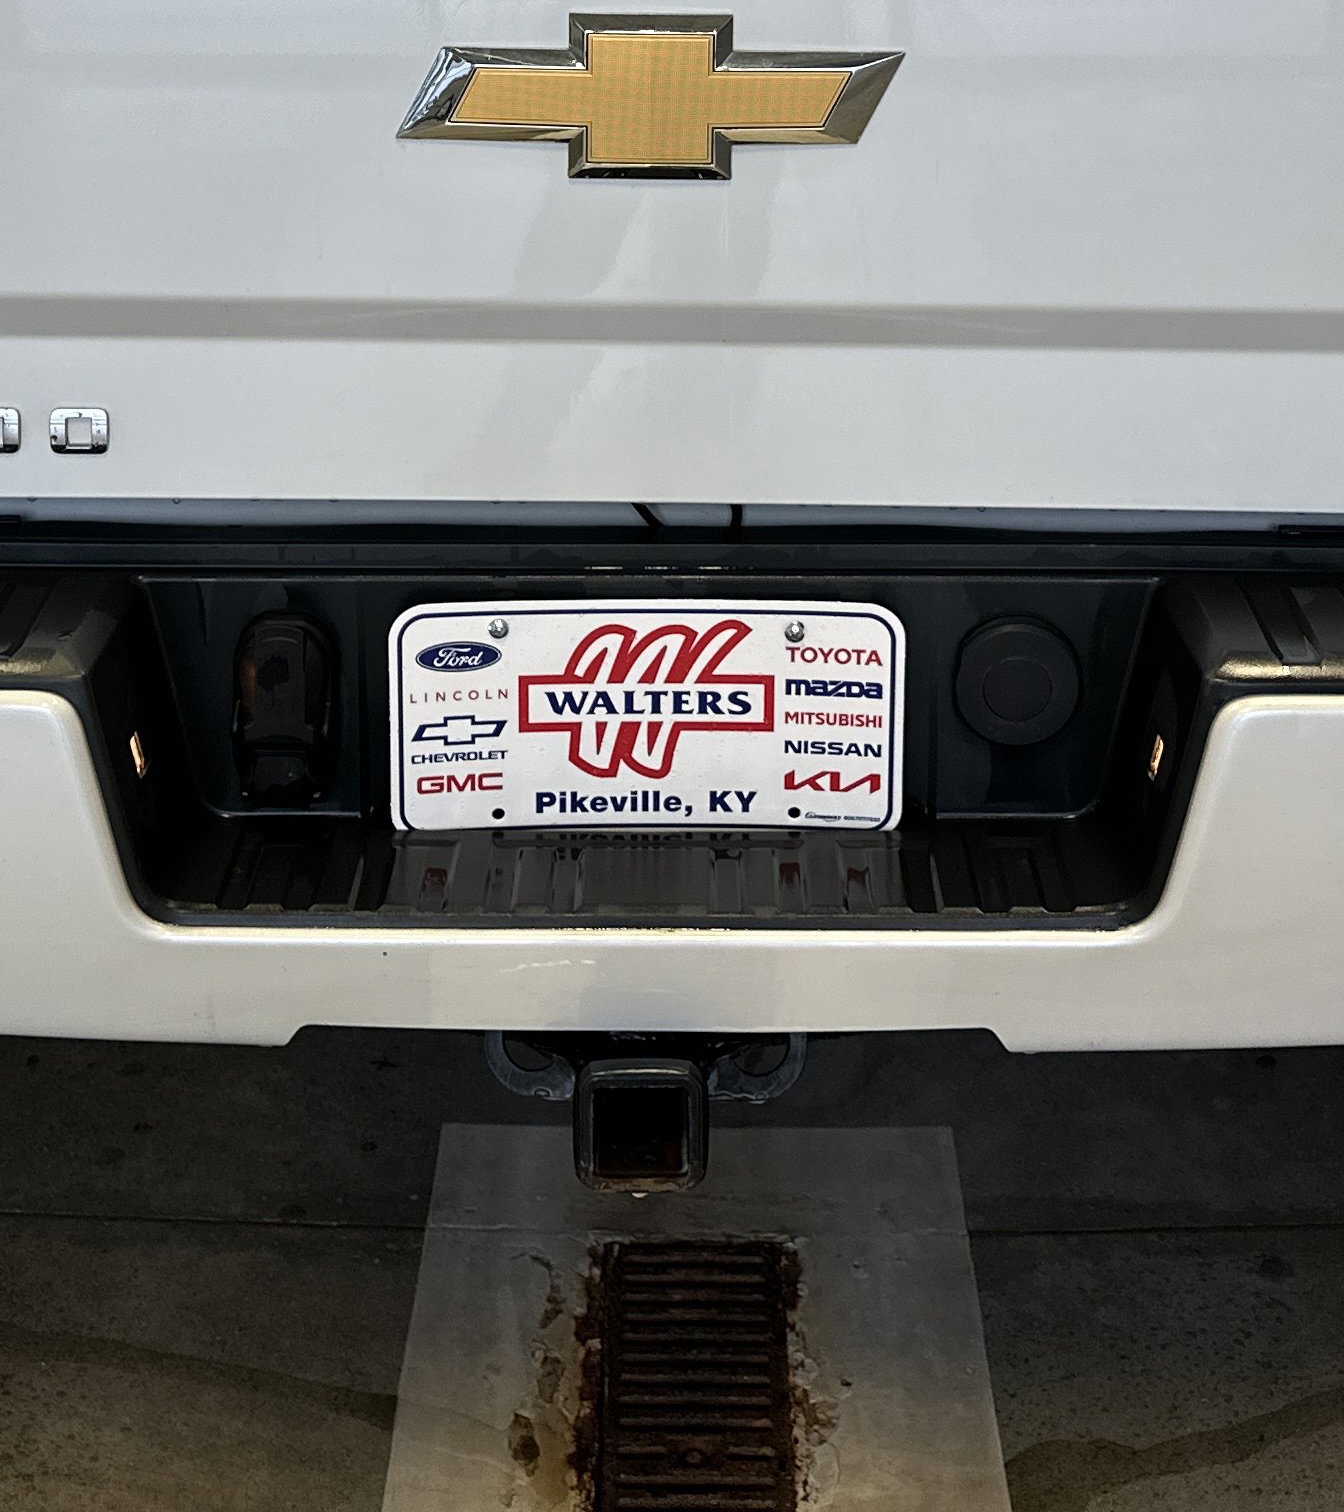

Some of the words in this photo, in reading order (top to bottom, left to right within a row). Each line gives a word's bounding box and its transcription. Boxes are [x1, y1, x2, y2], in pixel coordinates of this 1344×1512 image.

[785, 646, 883, 667] TOYOTA
[409, 688, 510, 705] LINCOLN
[785, 678, 883, 700] mazda
[544, 690, 753, 716] WALTERS
[784, 711, 883, 729] MITSUBISHI
[410, 749, 509, 766] CHEVROLET
[784, 740, 882, 758] NISSAN
[416, 772, 504, 795] GMC
[535, 789, 694, 819] Pikeville,
[709, 790, 758, 813] KY
